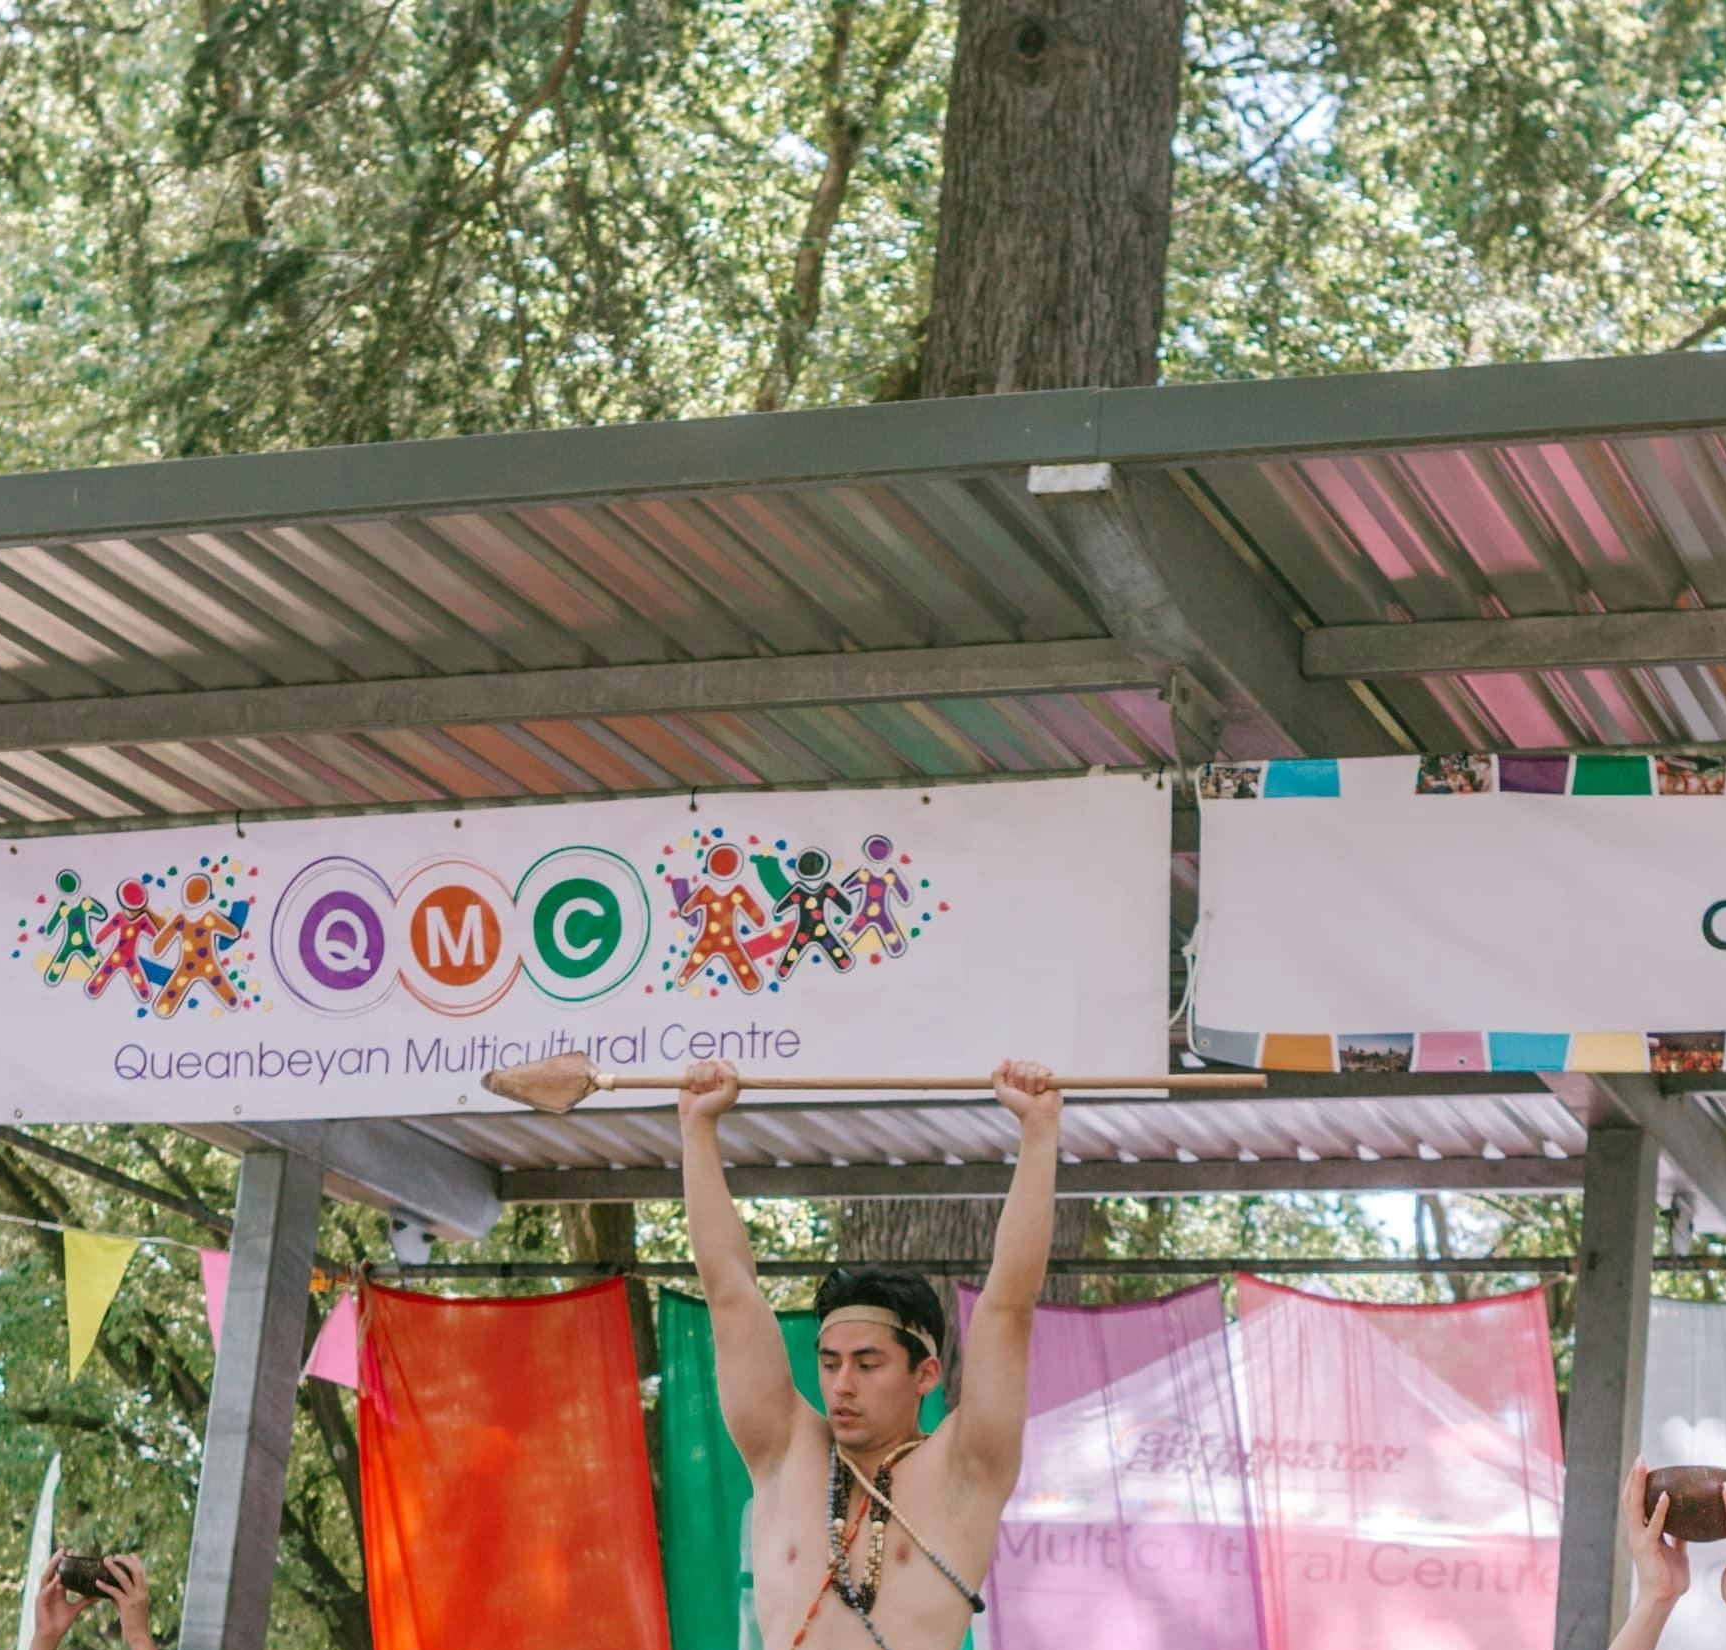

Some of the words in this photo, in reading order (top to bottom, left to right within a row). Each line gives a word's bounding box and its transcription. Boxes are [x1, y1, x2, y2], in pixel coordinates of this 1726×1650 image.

[113, 1040, 390, 1087] Queanbeyan
[405, 1025, 647, 1076] Multicultural
[659, 1023, 802, 1062] Centre
[1140, 1431, 1409, 1460] QUENBEYAN
[997, 1522, 1352, 1585] Multicultral
